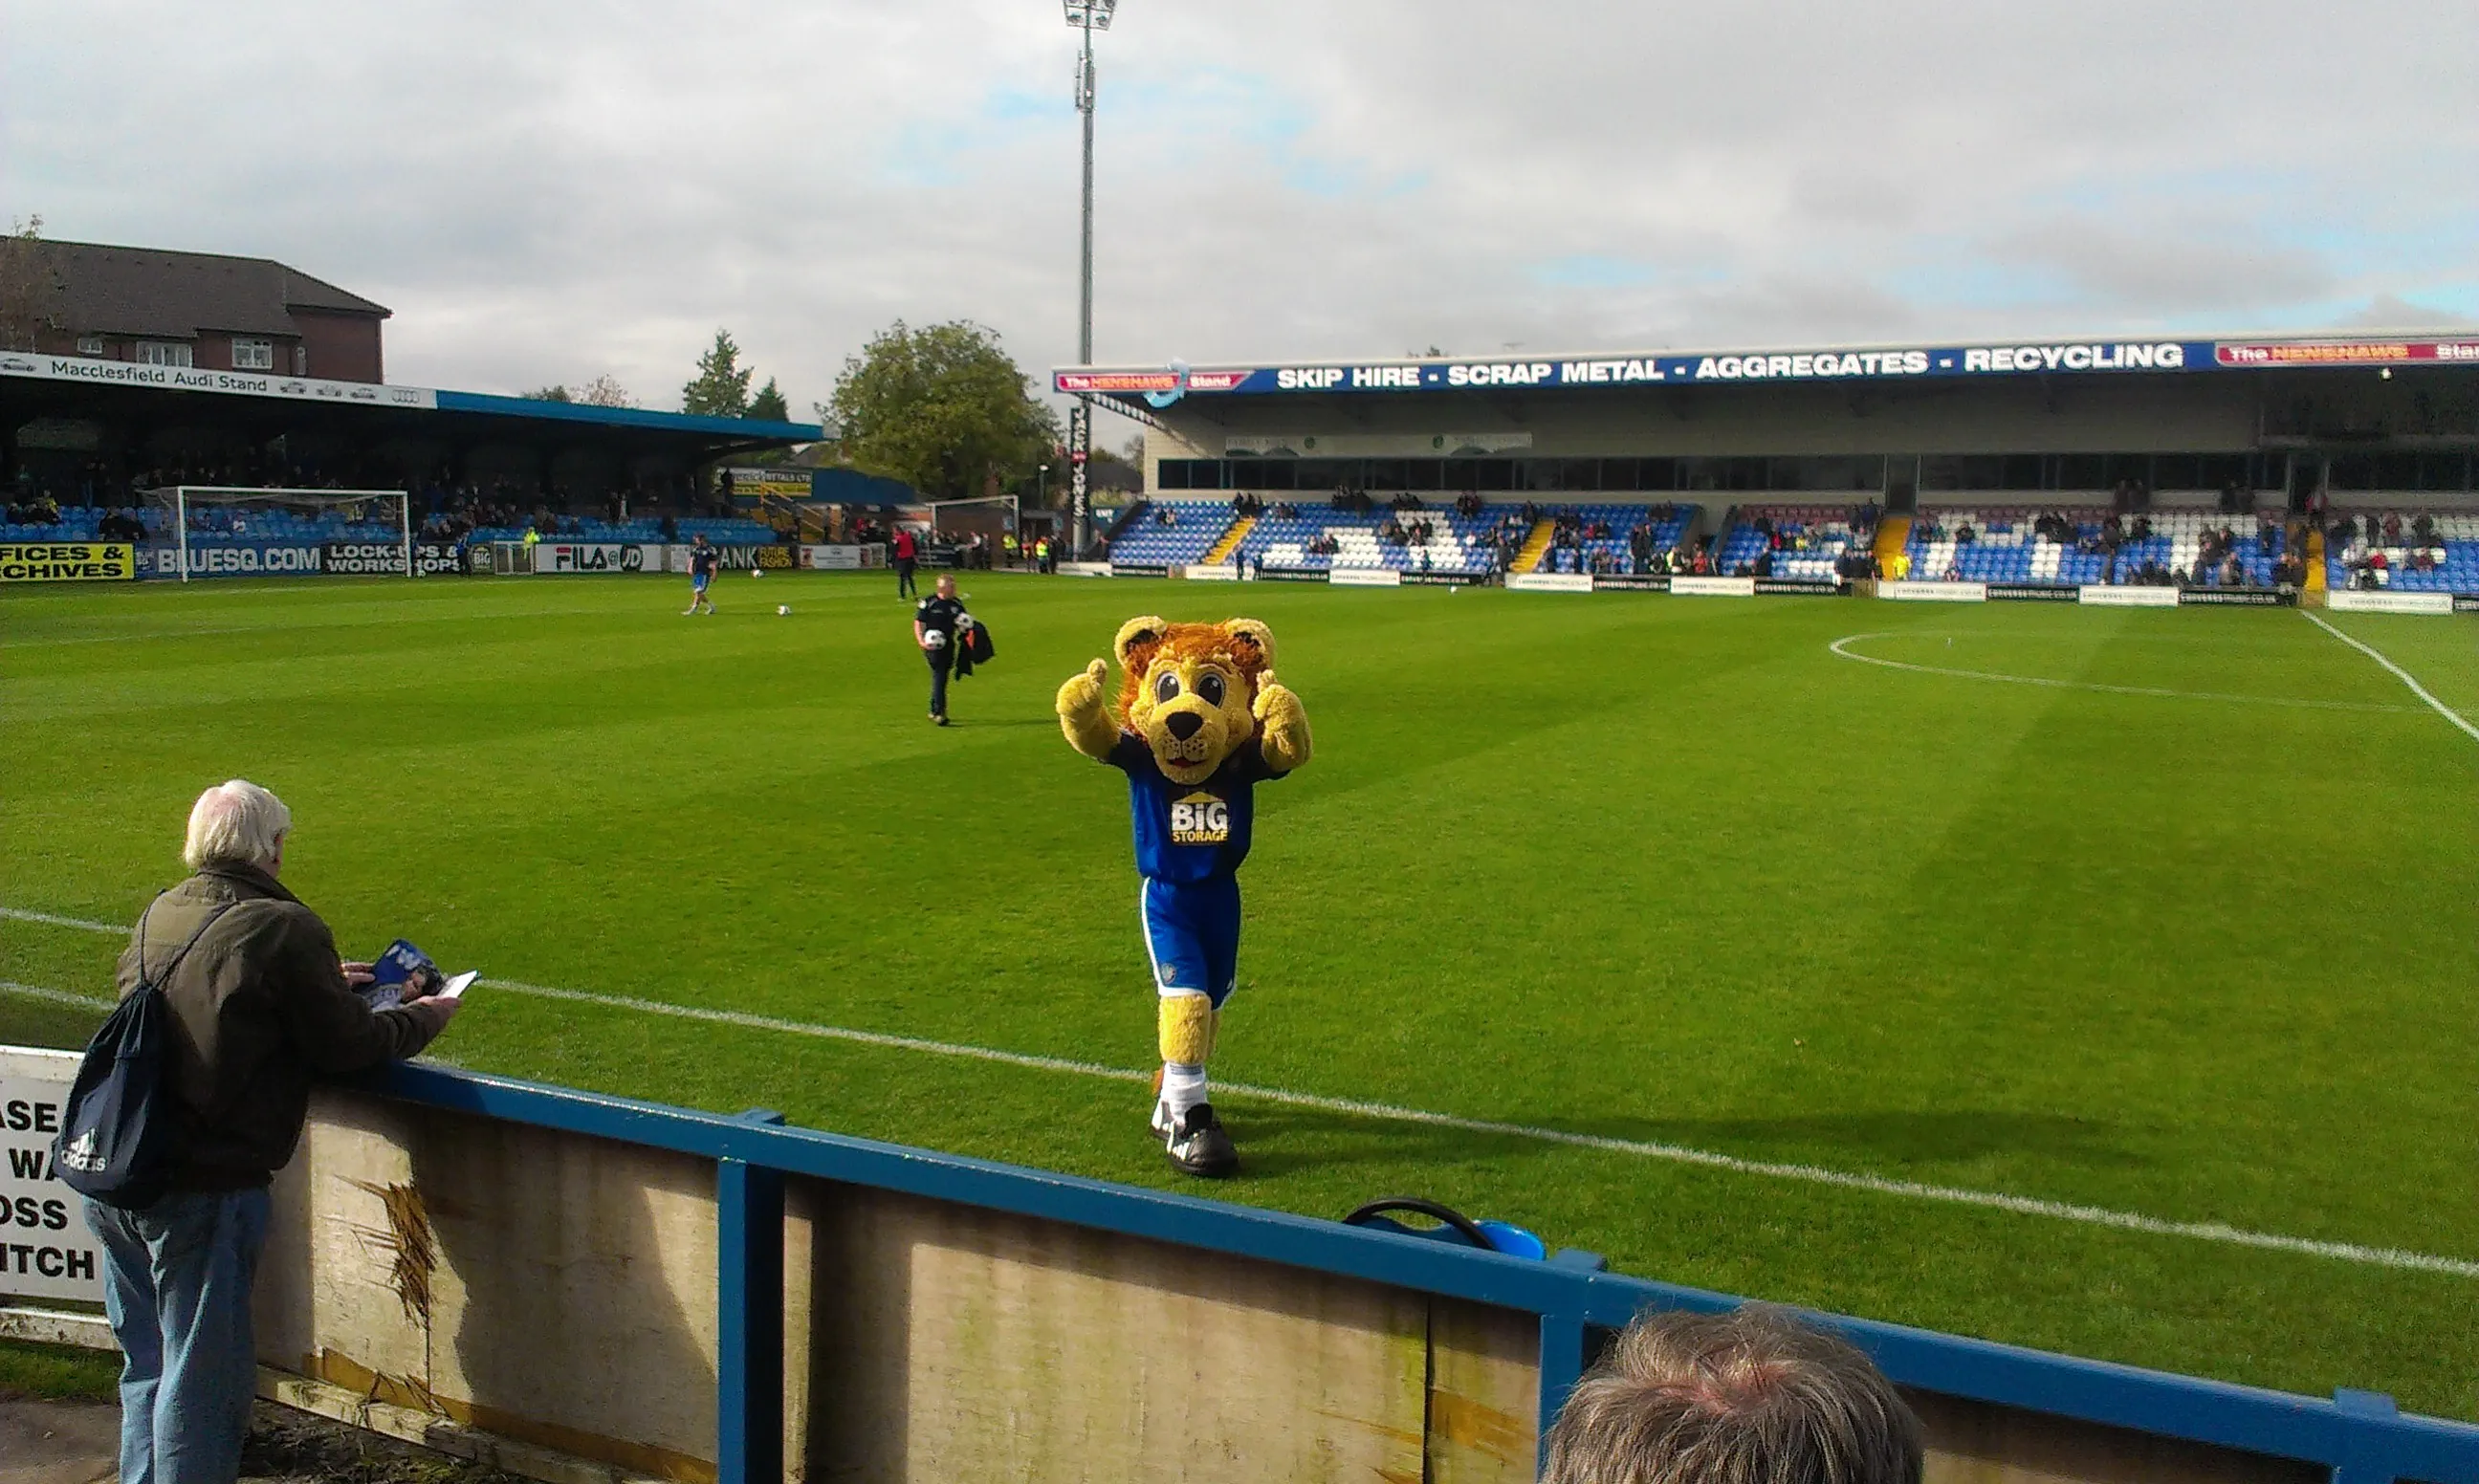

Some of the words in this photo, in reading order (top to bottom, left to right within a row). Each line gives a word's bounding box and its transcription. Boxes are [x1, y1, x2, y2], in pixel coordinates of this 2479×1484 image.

[2228, 345, 2269, 360] The
[1277, 367, 1343, 388] SKIP
[1352, 366, 1421, 387] HIRE
[1448, 363, 1552, 386] SCRAP
[1561, 360, 1664, 382] METAL
[1695, 351, 1928, 379] AGGREGATES
[1964, 343, 2184, 371] RECYCLING
[52, 360, 165, 382] Macclesfield
[174, 372, 213, 387] Audi
[219, 375, 268, 392] Stand
[1065, 377, 1089, 388] The
[1190, 373, 1231, 387] Stand
[102, 546, 124, 561] &
[556, 546, 607, 570] FILA
[712, 546, 758, 570] ANK
[760, 547, 789, 558] FUTURE
[158, 548, 320, 573] BLUESQ.COM
[759, 556, 793, 568] FASHION
[1172, 830, 1228, 842] STORAGE
